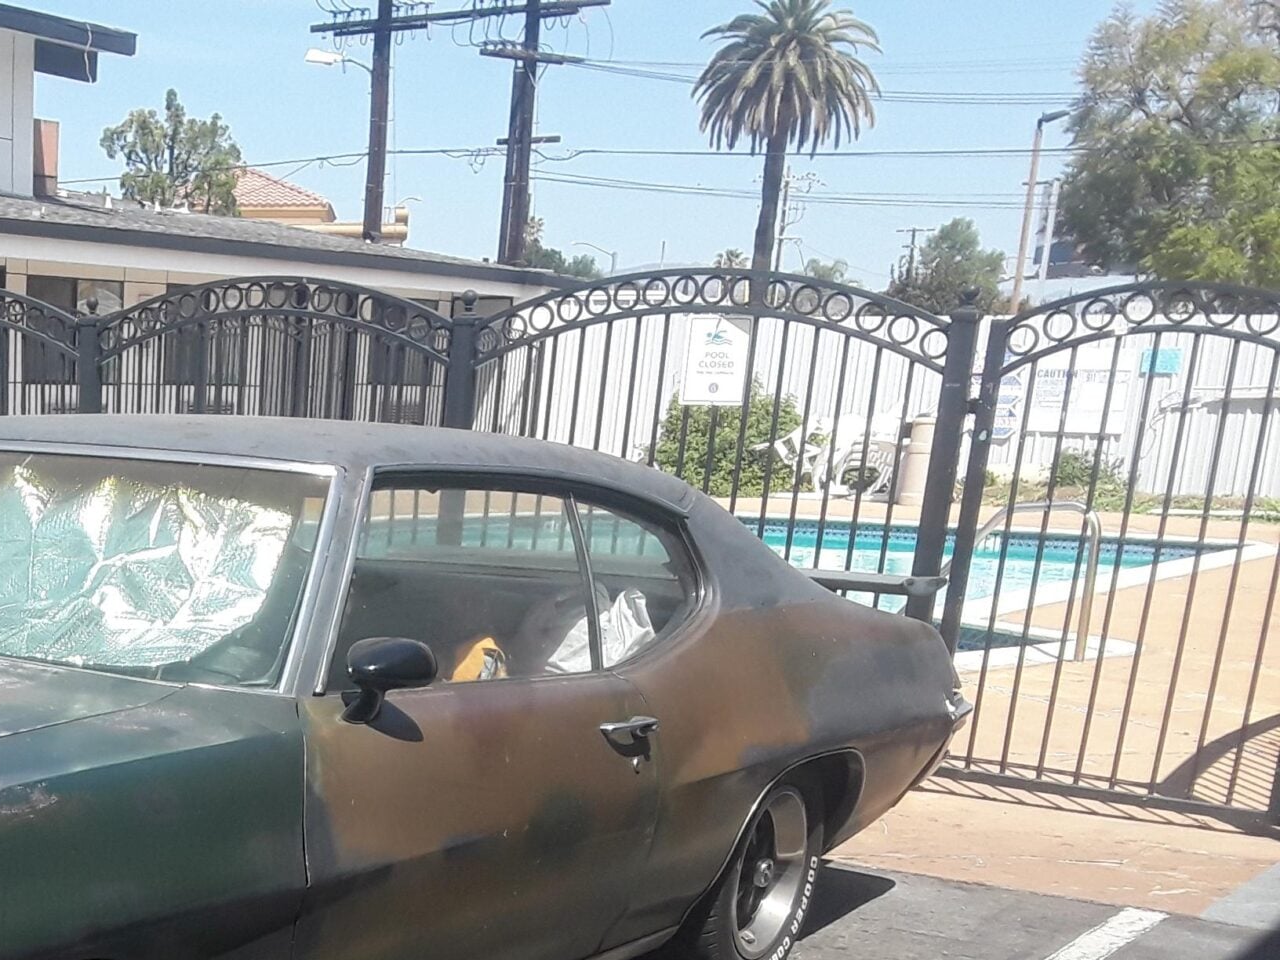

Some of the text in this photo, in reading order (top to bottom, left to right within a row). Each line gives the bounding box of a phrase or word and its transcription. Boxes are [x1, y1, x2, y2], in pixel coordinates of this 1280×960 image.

[698, 360, 734, 368] CLOSED
[1037, 368, 1078, 379] CAUTIN
[791, 856, 818, 936] COOPER
